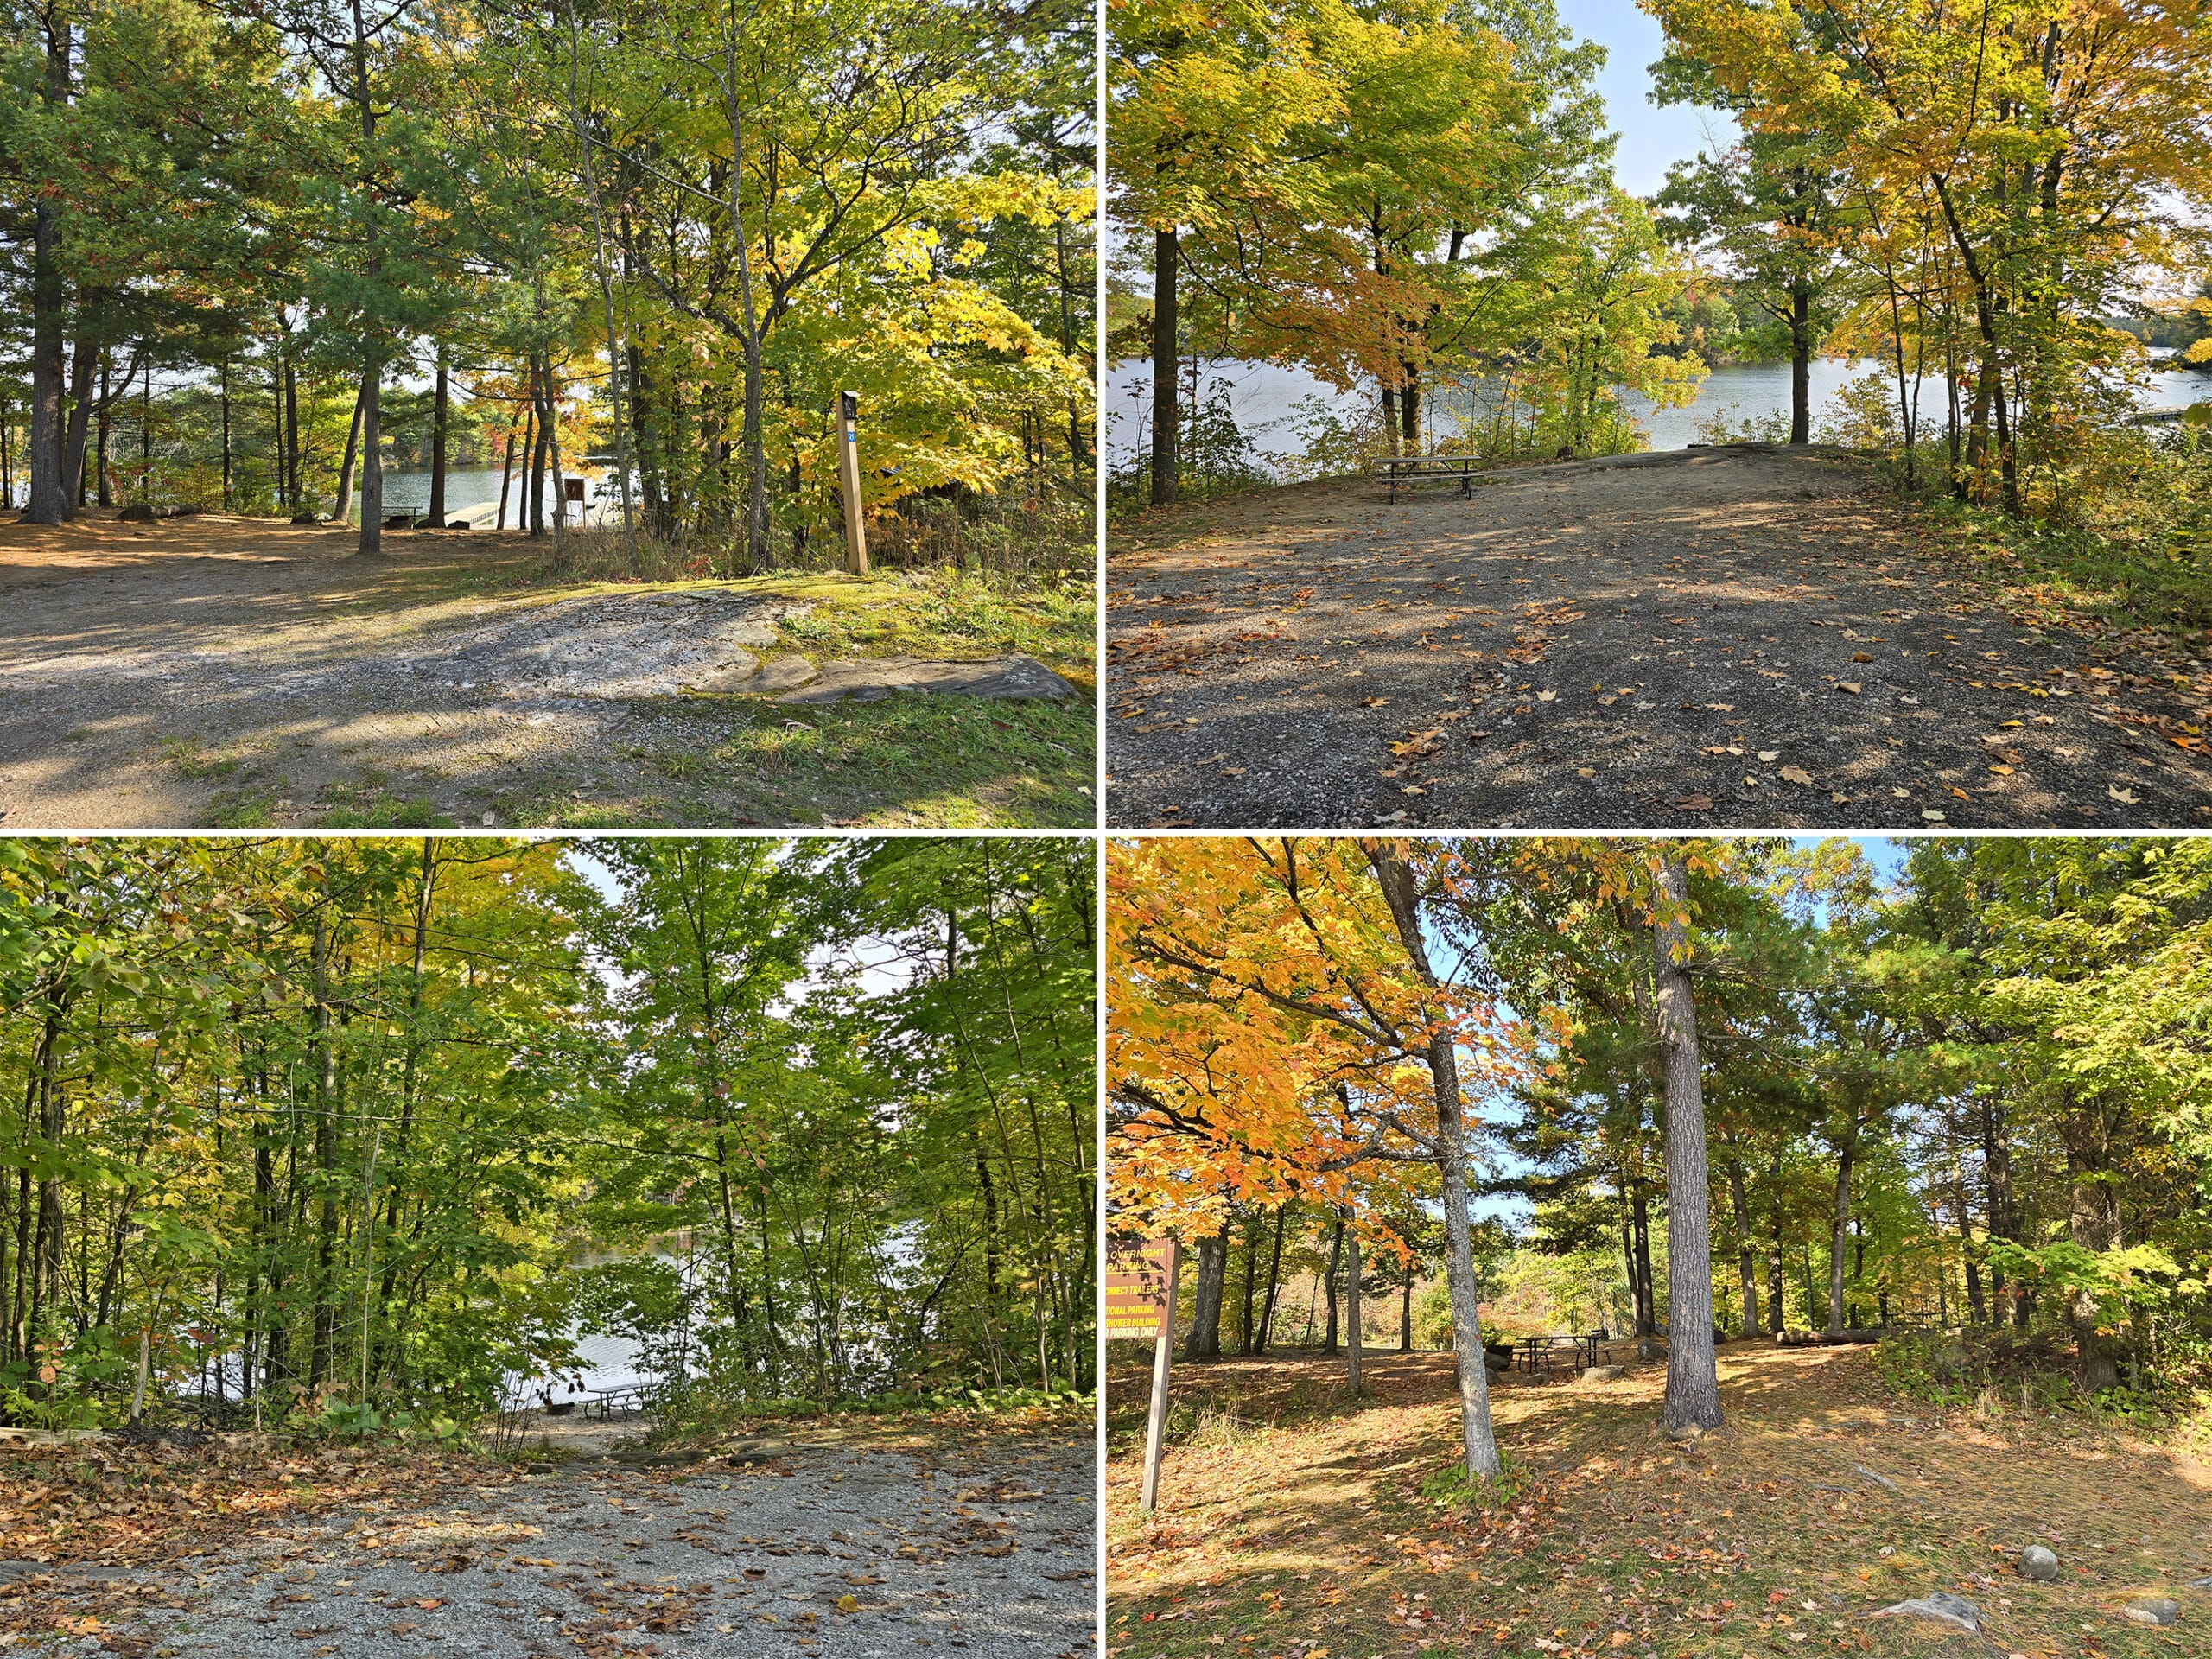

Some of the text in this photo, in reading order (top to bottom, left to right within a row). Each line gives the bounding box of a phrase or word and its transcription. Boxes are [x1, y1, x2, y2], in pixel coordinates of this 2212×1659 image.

[1110, 1248, 1166, 1260] OVERNIGHT
[1106, 1262, 1150, 1272] PARKING
[1130, 1284, 1159, 1294] TRAILERS
[1128, 1305, 1155, 1314] PARKING
[1105, 1317, 1160, 1328] SHOWER BUILDING
[1110, 1327, 1139, 1338] PARKING
[1140, 1326, 1159, 1337] ONLY
